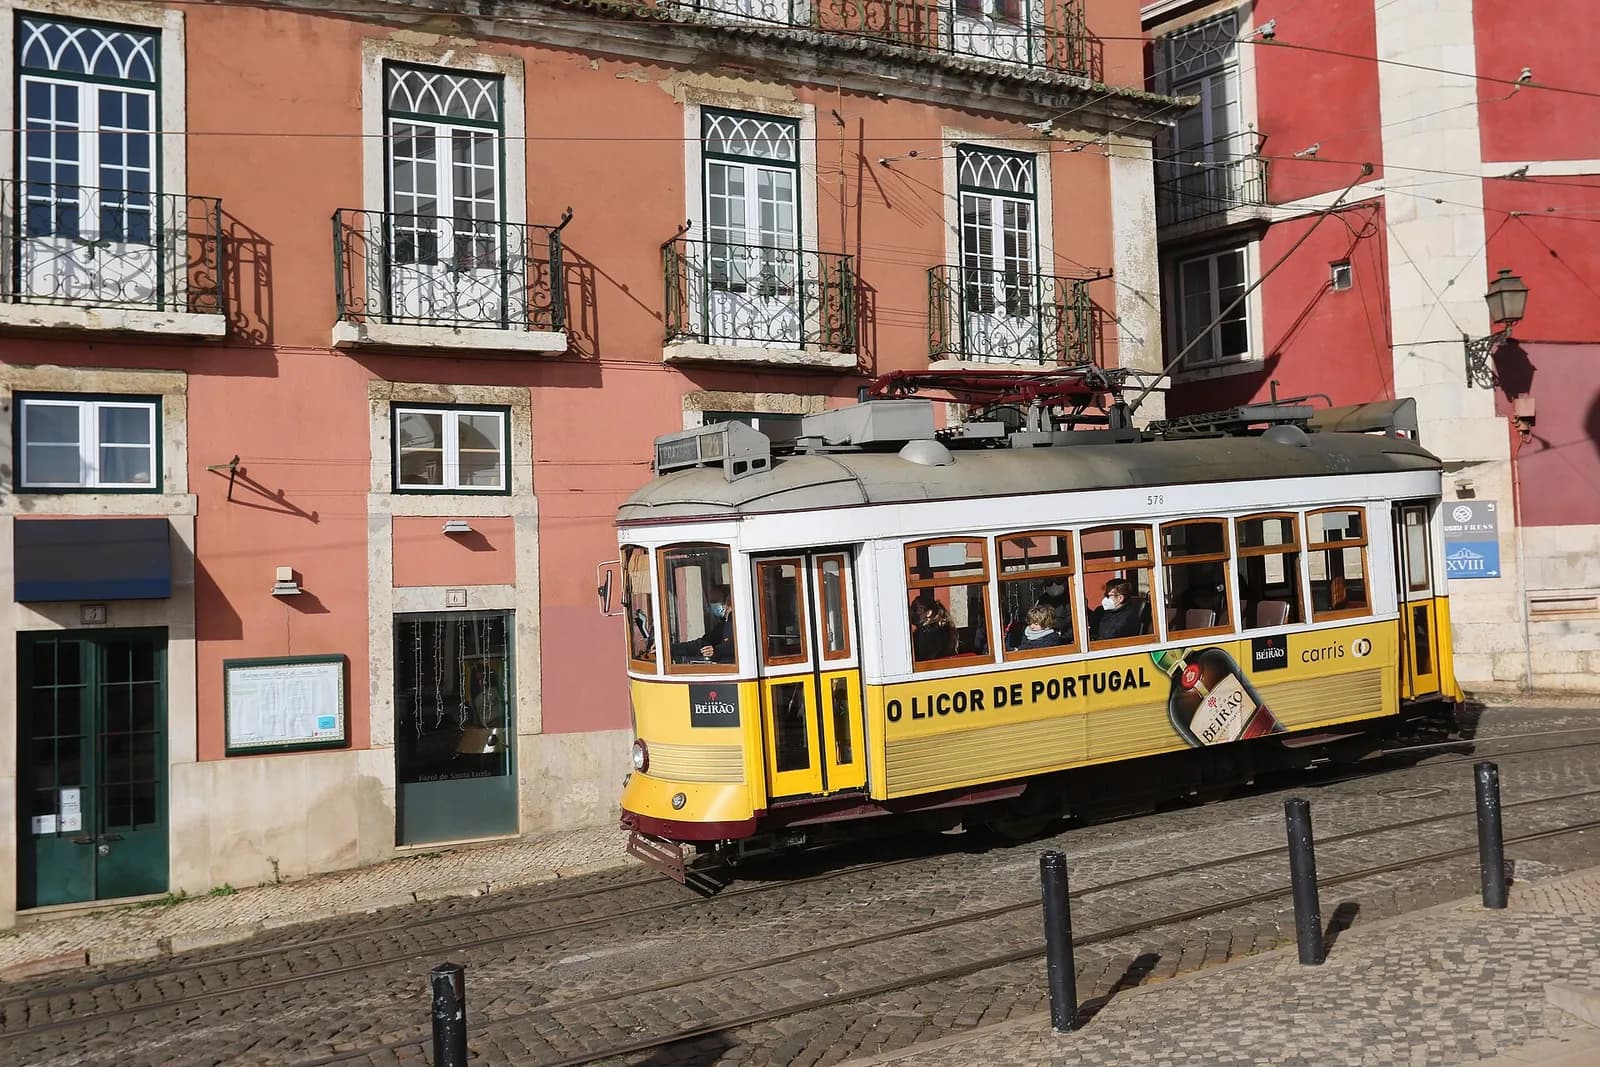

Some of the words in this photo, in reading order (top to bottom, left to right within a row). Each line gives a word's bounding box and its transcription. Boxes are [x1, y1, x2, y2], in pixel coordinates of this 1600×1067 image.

[1147, 495, 1164, 505] 578
[1447, 559, 1485, 571] XVIII
[1255, 647, 1285, 661] BEIRÃO
[1301, 641, 1345, 663] carris
[886, 699, 901, 722] O
[912, 688, 985, 720] LICOR
[993, 684, 1023, 709] DE
[1031, 667, 1151, 703] PORTUGAL
[694, 703, 735, 714] BEIRÃO
[1202, 690, 1243, 743] BEIRÃO
